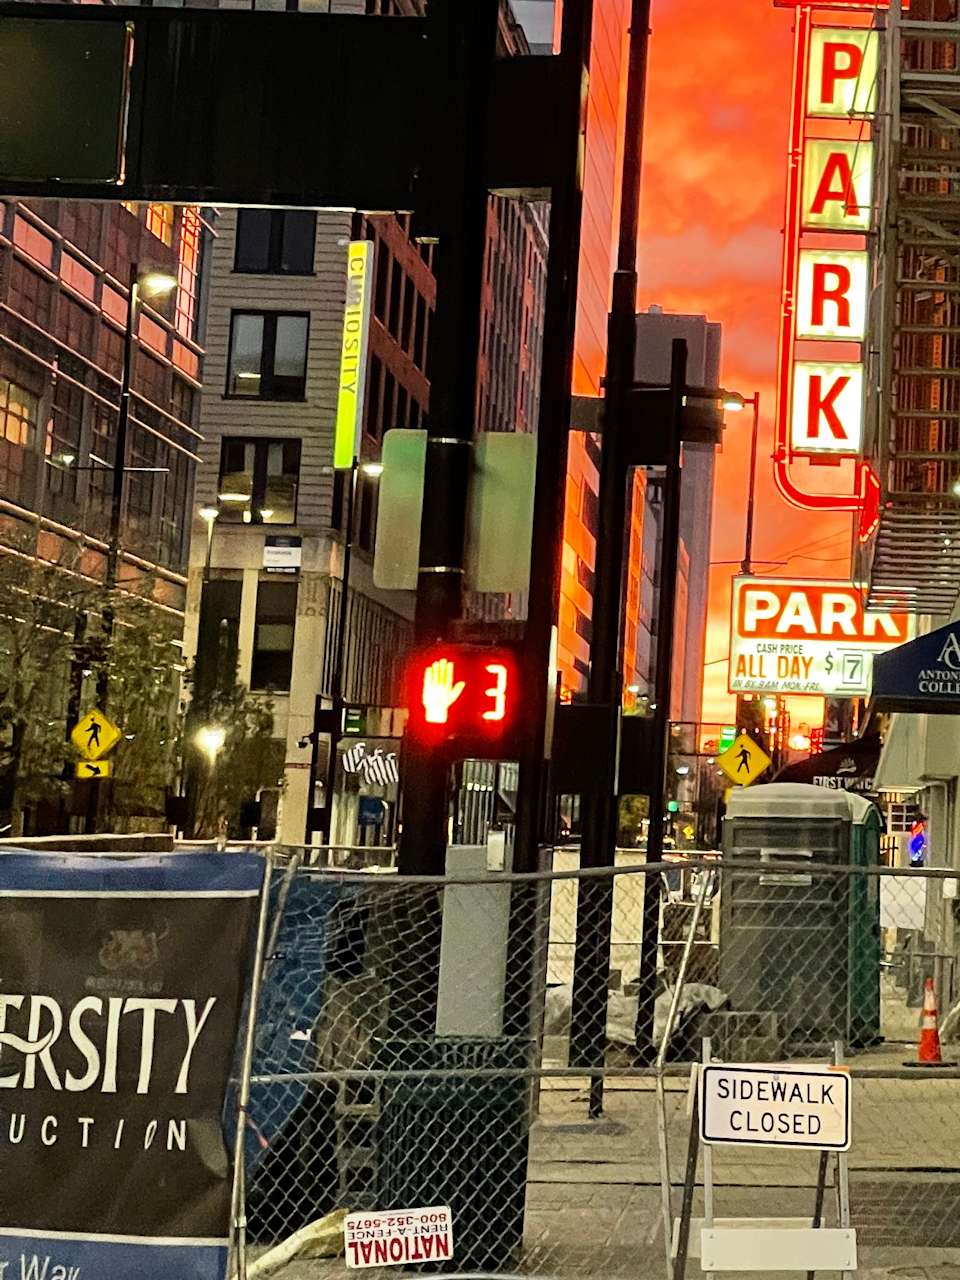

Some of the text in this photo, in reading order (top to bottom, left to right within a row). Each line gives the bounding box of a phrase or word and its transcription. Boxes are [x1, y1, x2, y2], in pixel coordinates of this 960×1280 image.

[806, 42, 863, 440] PARK
[756, 643, 804, 655] CASH PRICE
[735, 654, 767, 678] ALL
[777, 655, 814, 680] DAY
[846, 659, 861, 680] 7
[482, 664, 508, 721] 3
[813, 775, 843, 789] FIRST
[717, 1078, 835, 1105] SIDEWALK
[730, 1110, 821, 1136] CLOSED
[347, 1223, 448, 1240] RENT-A-FENCE
[348, 1233, 449, 1265] NATIONAL
